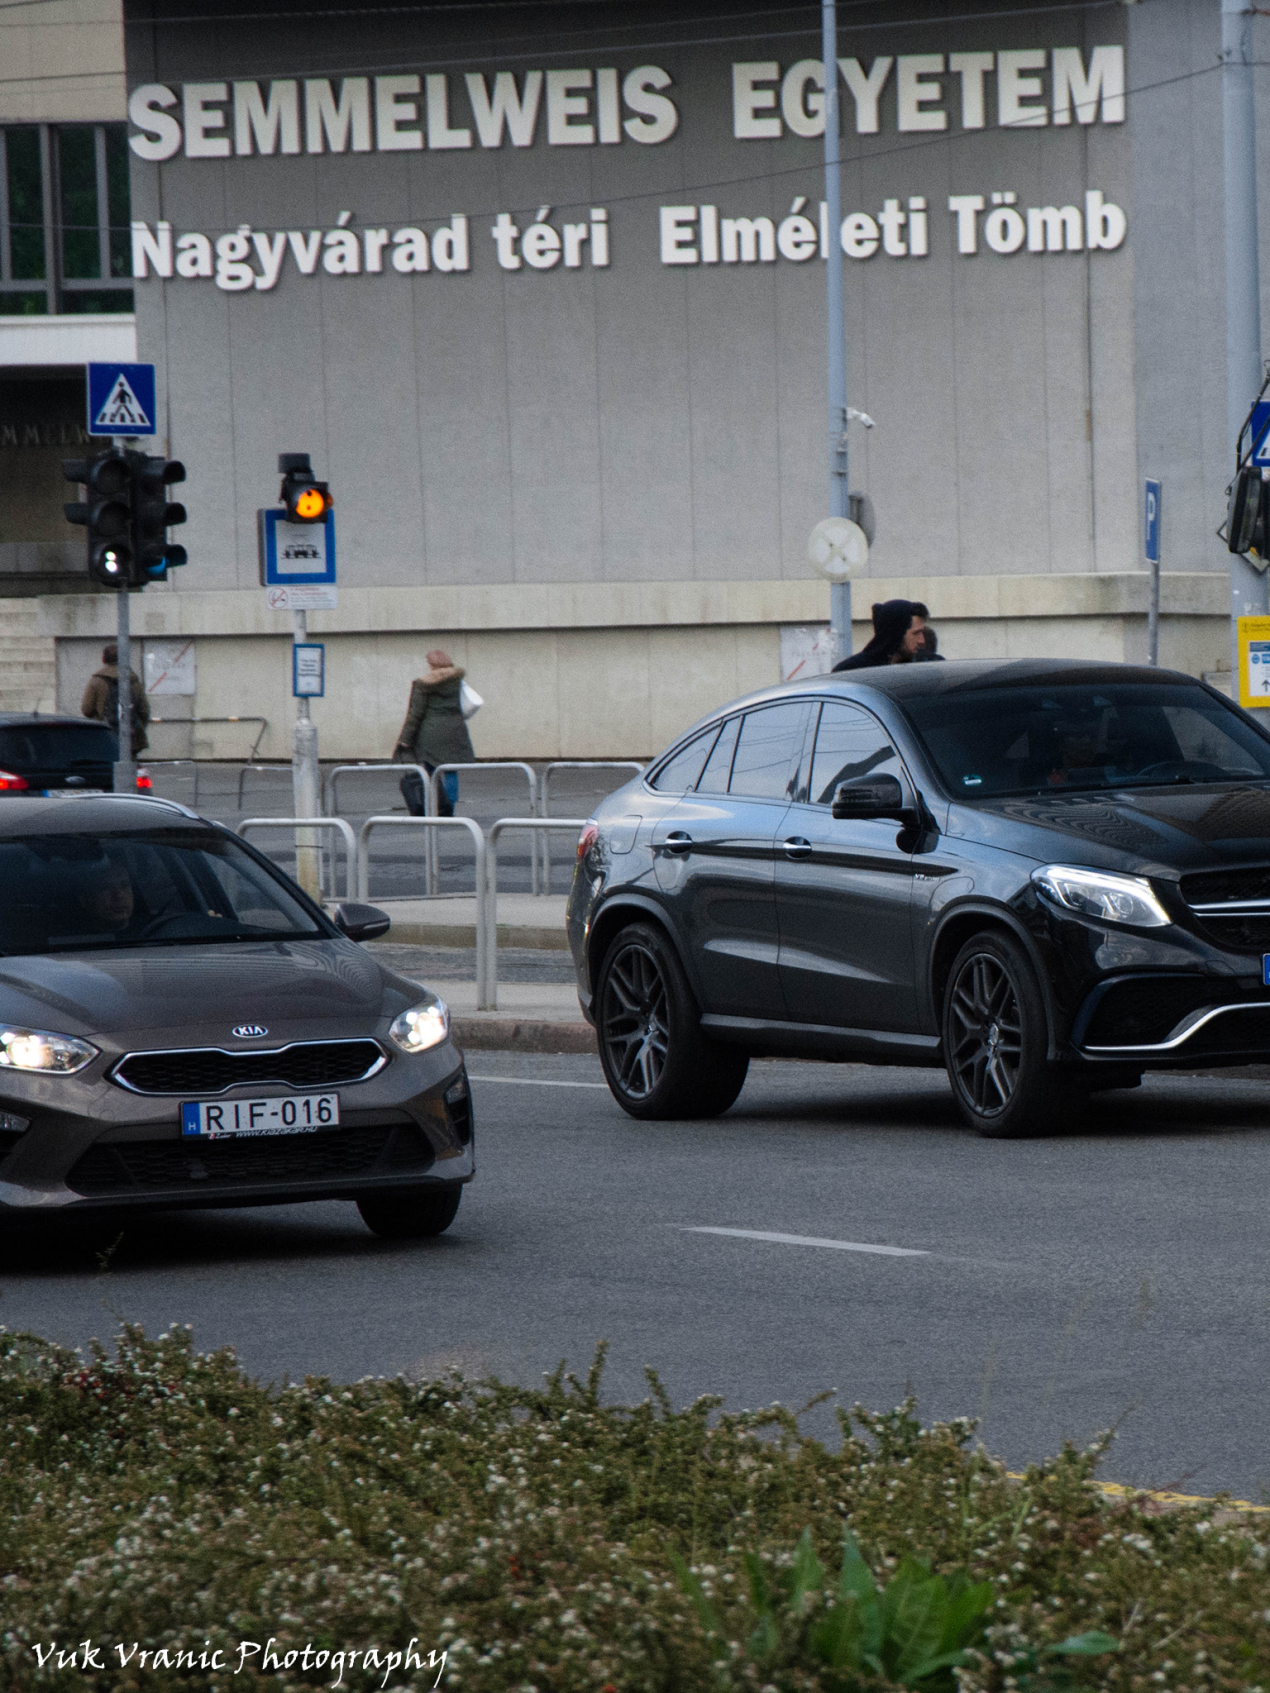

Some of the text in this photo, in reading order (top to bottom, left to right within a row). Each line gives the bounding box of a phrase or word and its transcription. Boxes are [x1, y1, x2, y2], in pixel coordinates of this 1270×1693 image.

[128, 45, 1126, 162] SEMMELWEIS EGYETEM
[131, 211, 470, 291] Nagyvárad
[492, 205, 611, 270] téri
[948, 190, 1128, 255] Tömb
[238, 1026, 264, 1035] KIA
[188, 1121, 197, 1131] H
[205, 1097, 332, 1131] RIF-016
